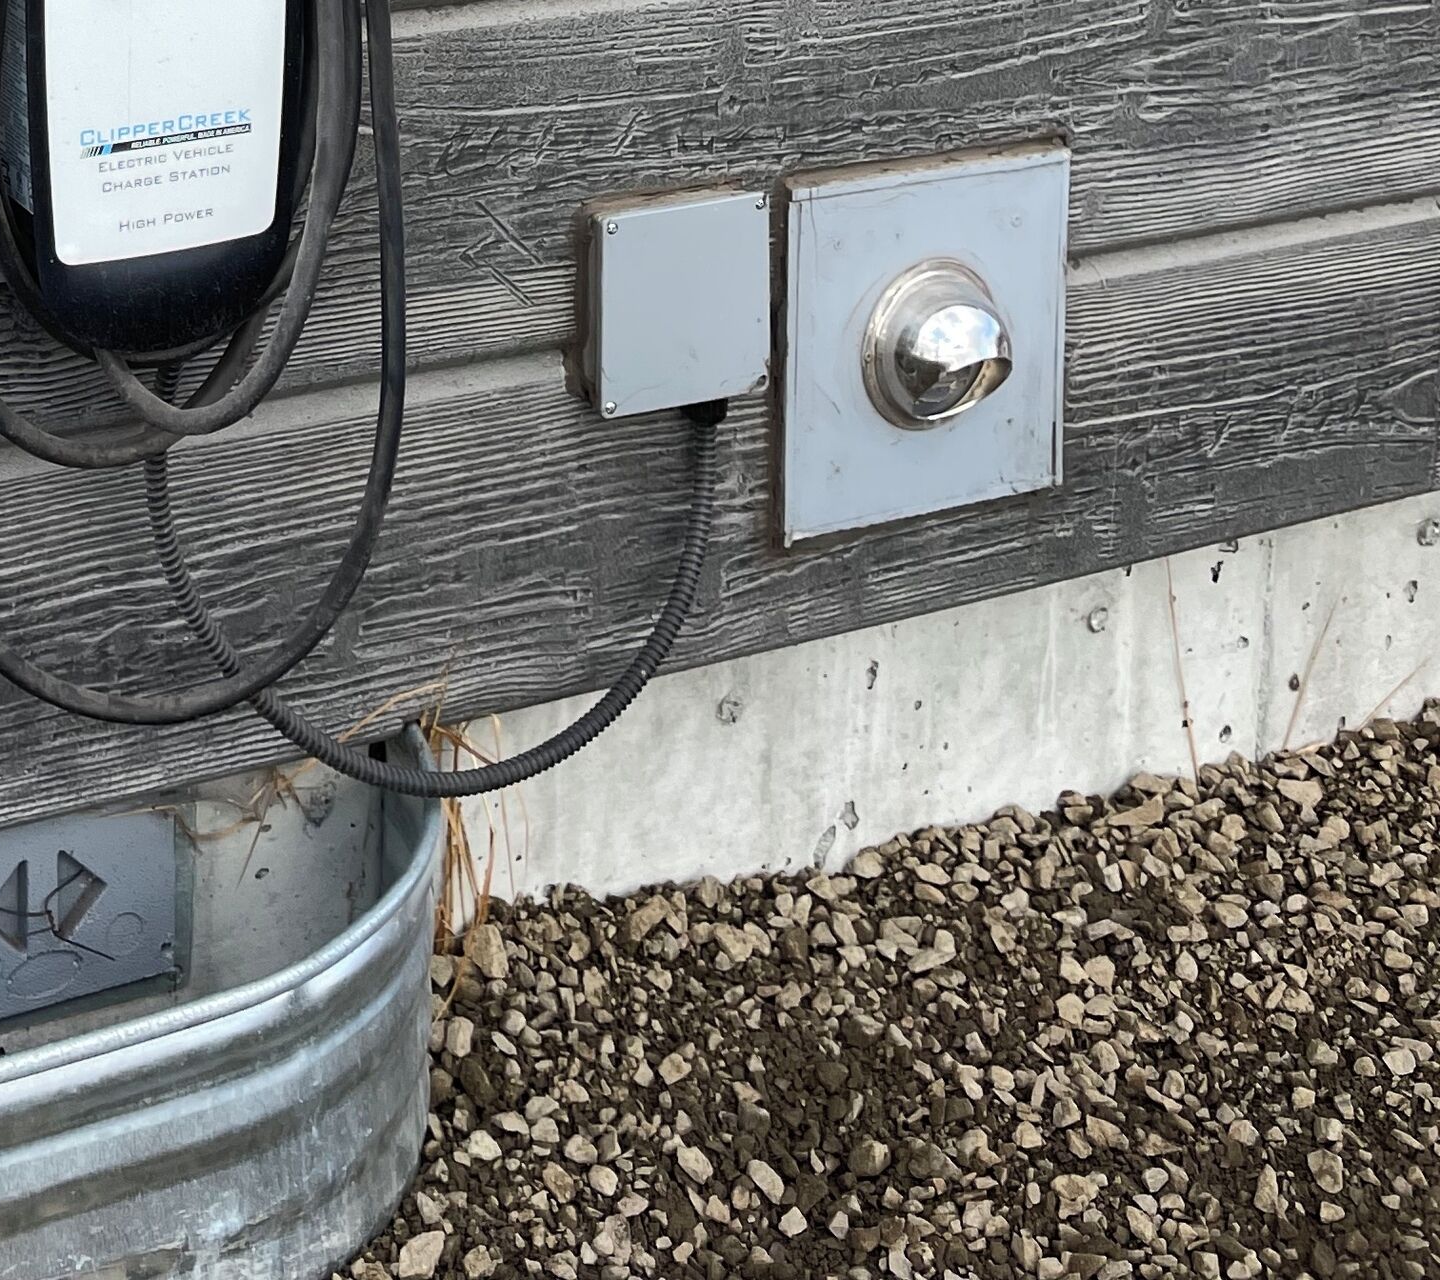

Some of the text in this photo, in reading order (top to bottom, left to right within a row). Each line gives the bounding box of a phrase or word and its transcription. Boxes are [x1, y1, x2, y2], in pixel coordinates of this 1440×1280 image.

[98, 143, 234, 173] ELECTRIC VEHICLE
[101, 164, 231, 193] CHARGE STATION
[118, 207, 214, 232] HIGH POWER
